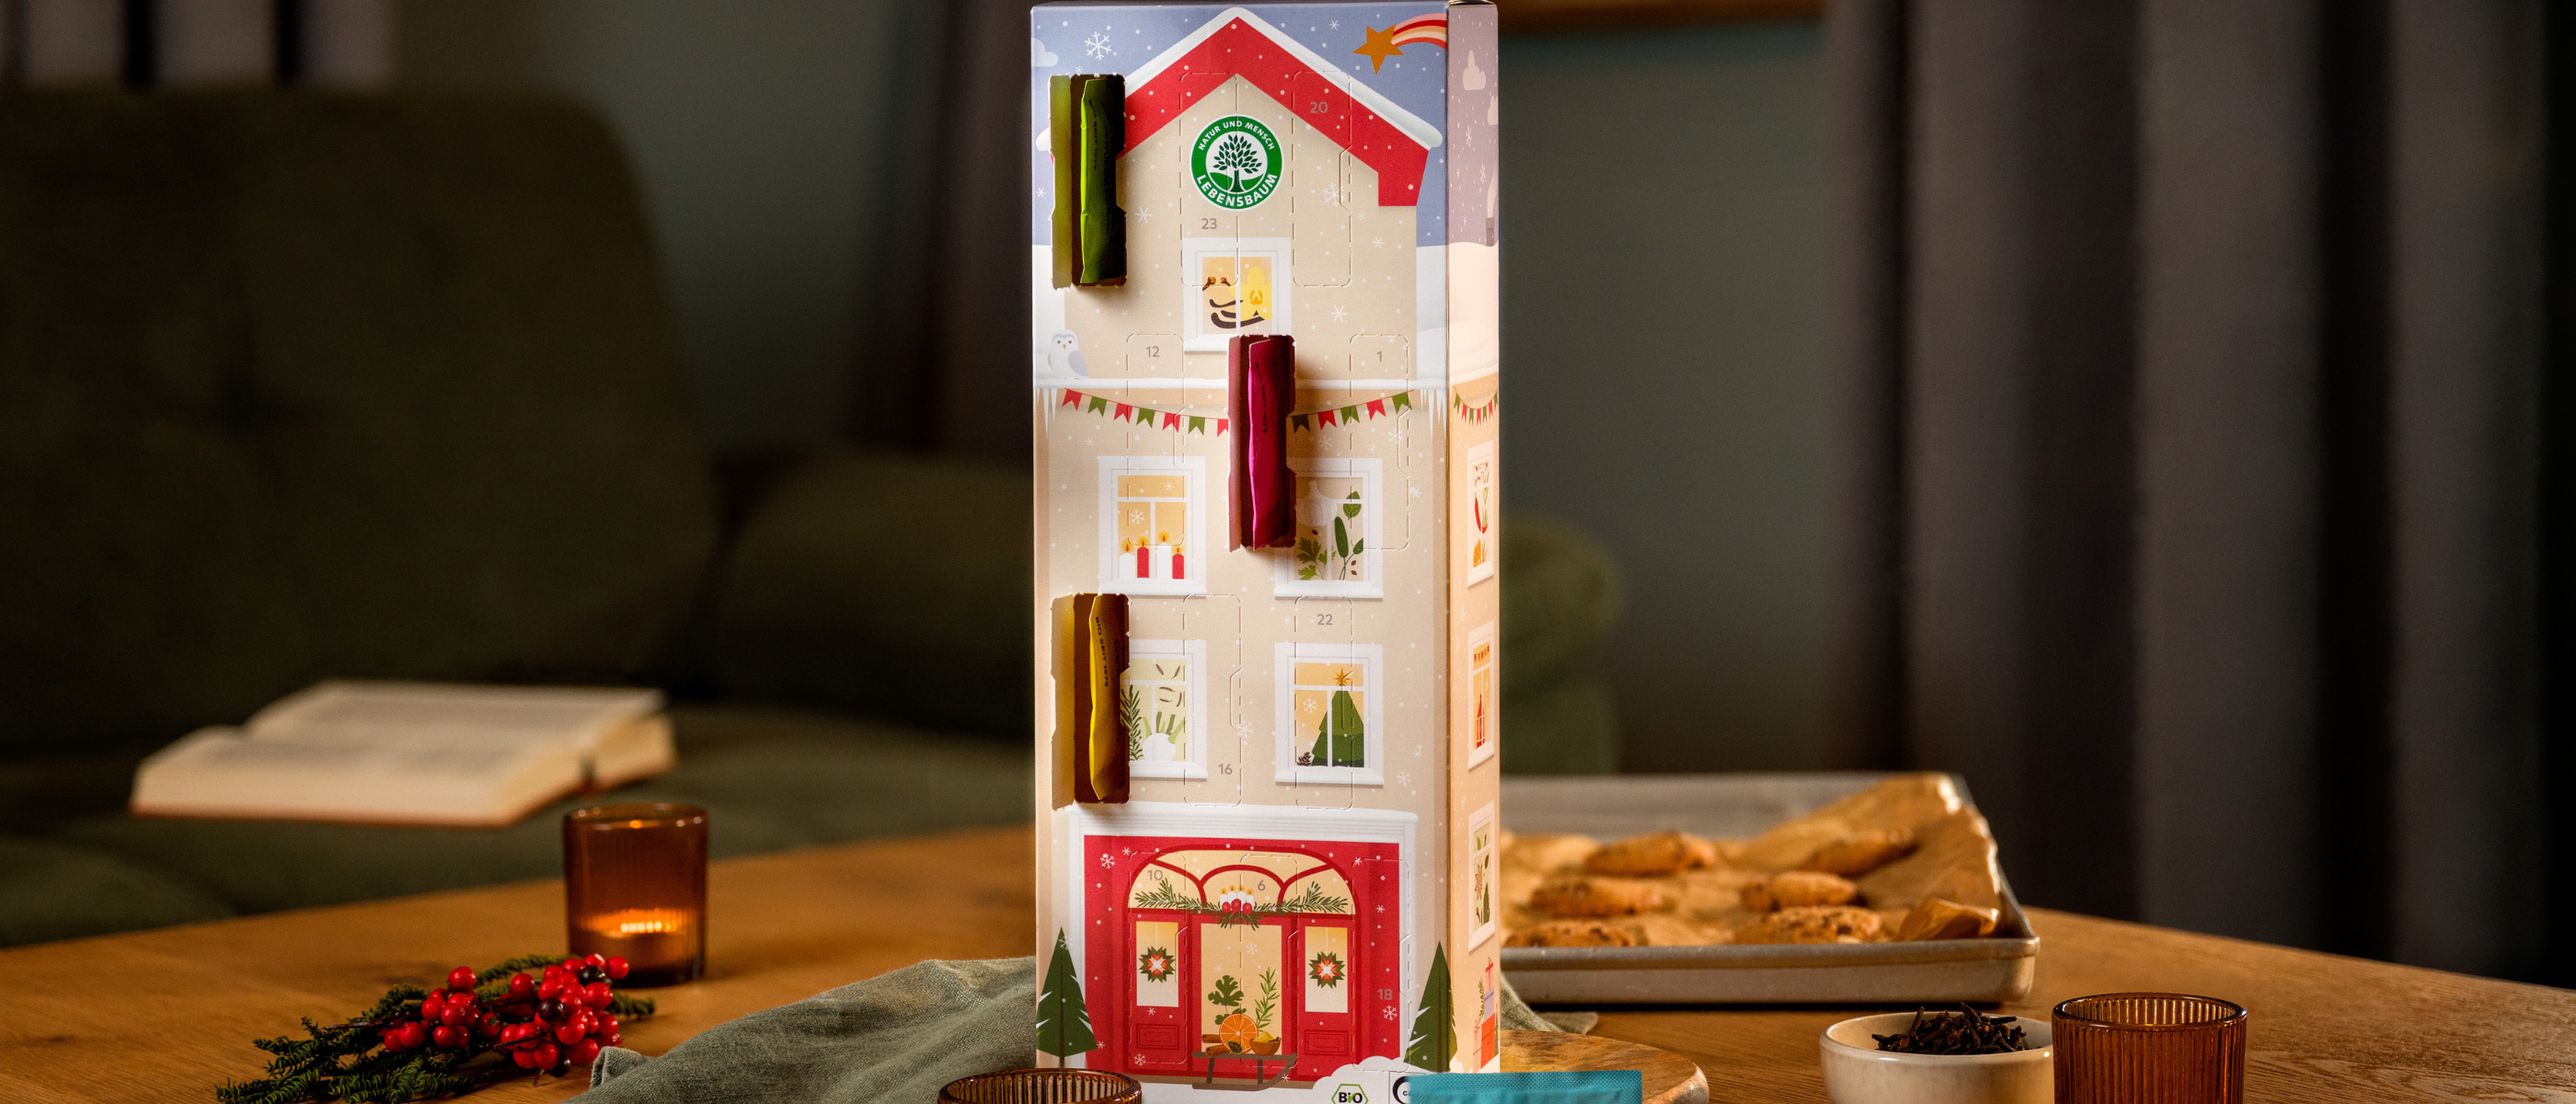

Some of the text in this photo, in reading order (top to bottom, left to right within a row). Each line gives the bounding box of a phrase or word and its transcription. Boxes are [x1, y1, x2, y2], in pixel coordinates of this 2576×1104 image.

[1309, 101, 1328, 113] 20
[1198, 120, 1275, 151] NATUR UND MENSCH
[1196, 173, 1278, 207] LEBENSBAUM
[1201, 217, 1217, 230] 23
[1145, 346, 1160, 358] 12
[1376, 351, 1383, 362] 1
[1317, 614, 1333, 626] 22
[1098, 638, 1107, 661] SEIT
[1218, 764, 1233, 776] 16
[1146, 869, 1164, 881] 10
[1257, 880, 1266, 891] 6
[1376, 989, 1393, 1001] 18
